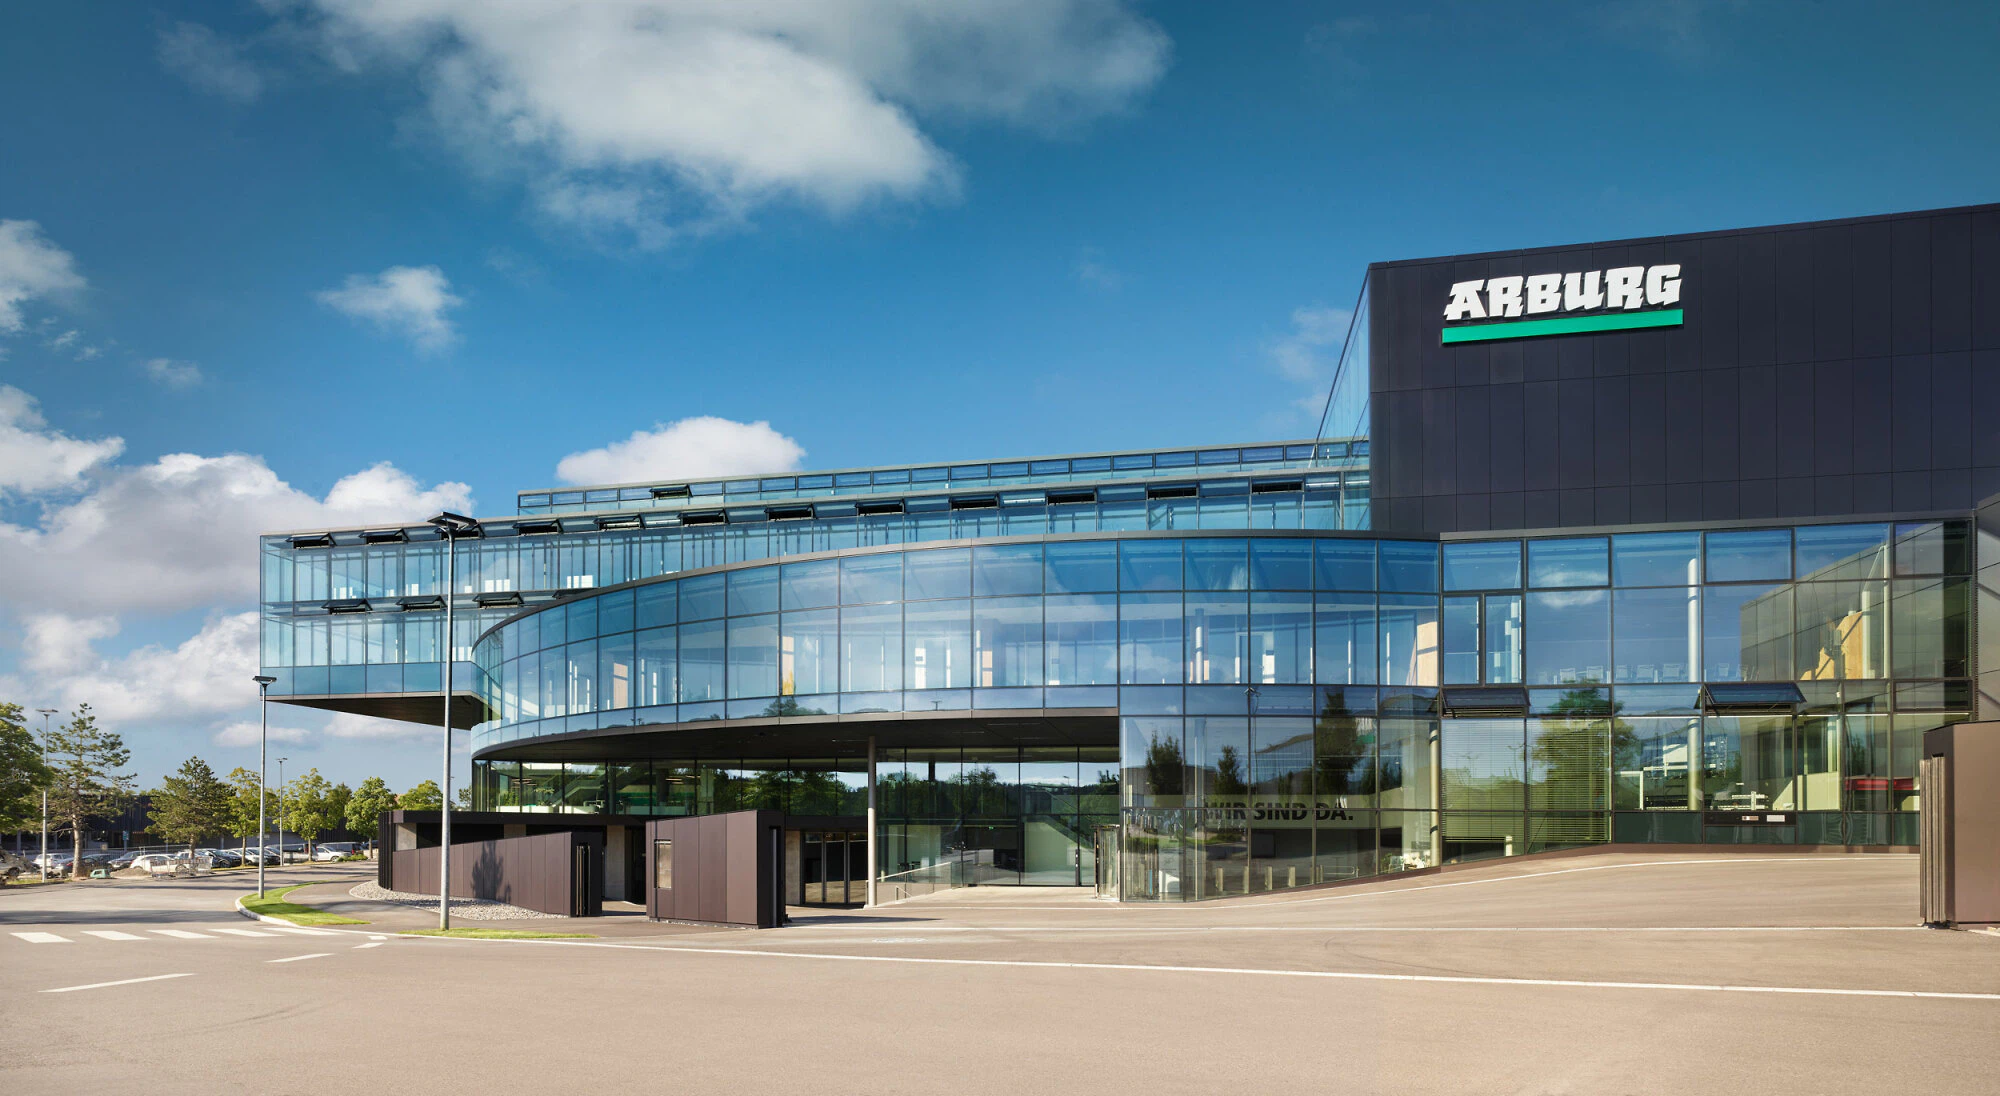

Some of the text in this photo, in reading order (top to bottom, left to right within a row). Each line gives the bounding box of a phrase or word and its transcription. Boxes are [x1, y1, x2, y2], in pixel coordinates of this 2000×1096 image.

[1443, 264, 1682, 321] ARBURG
[1203, 802, 1354, 820] WIR SIND DA.
